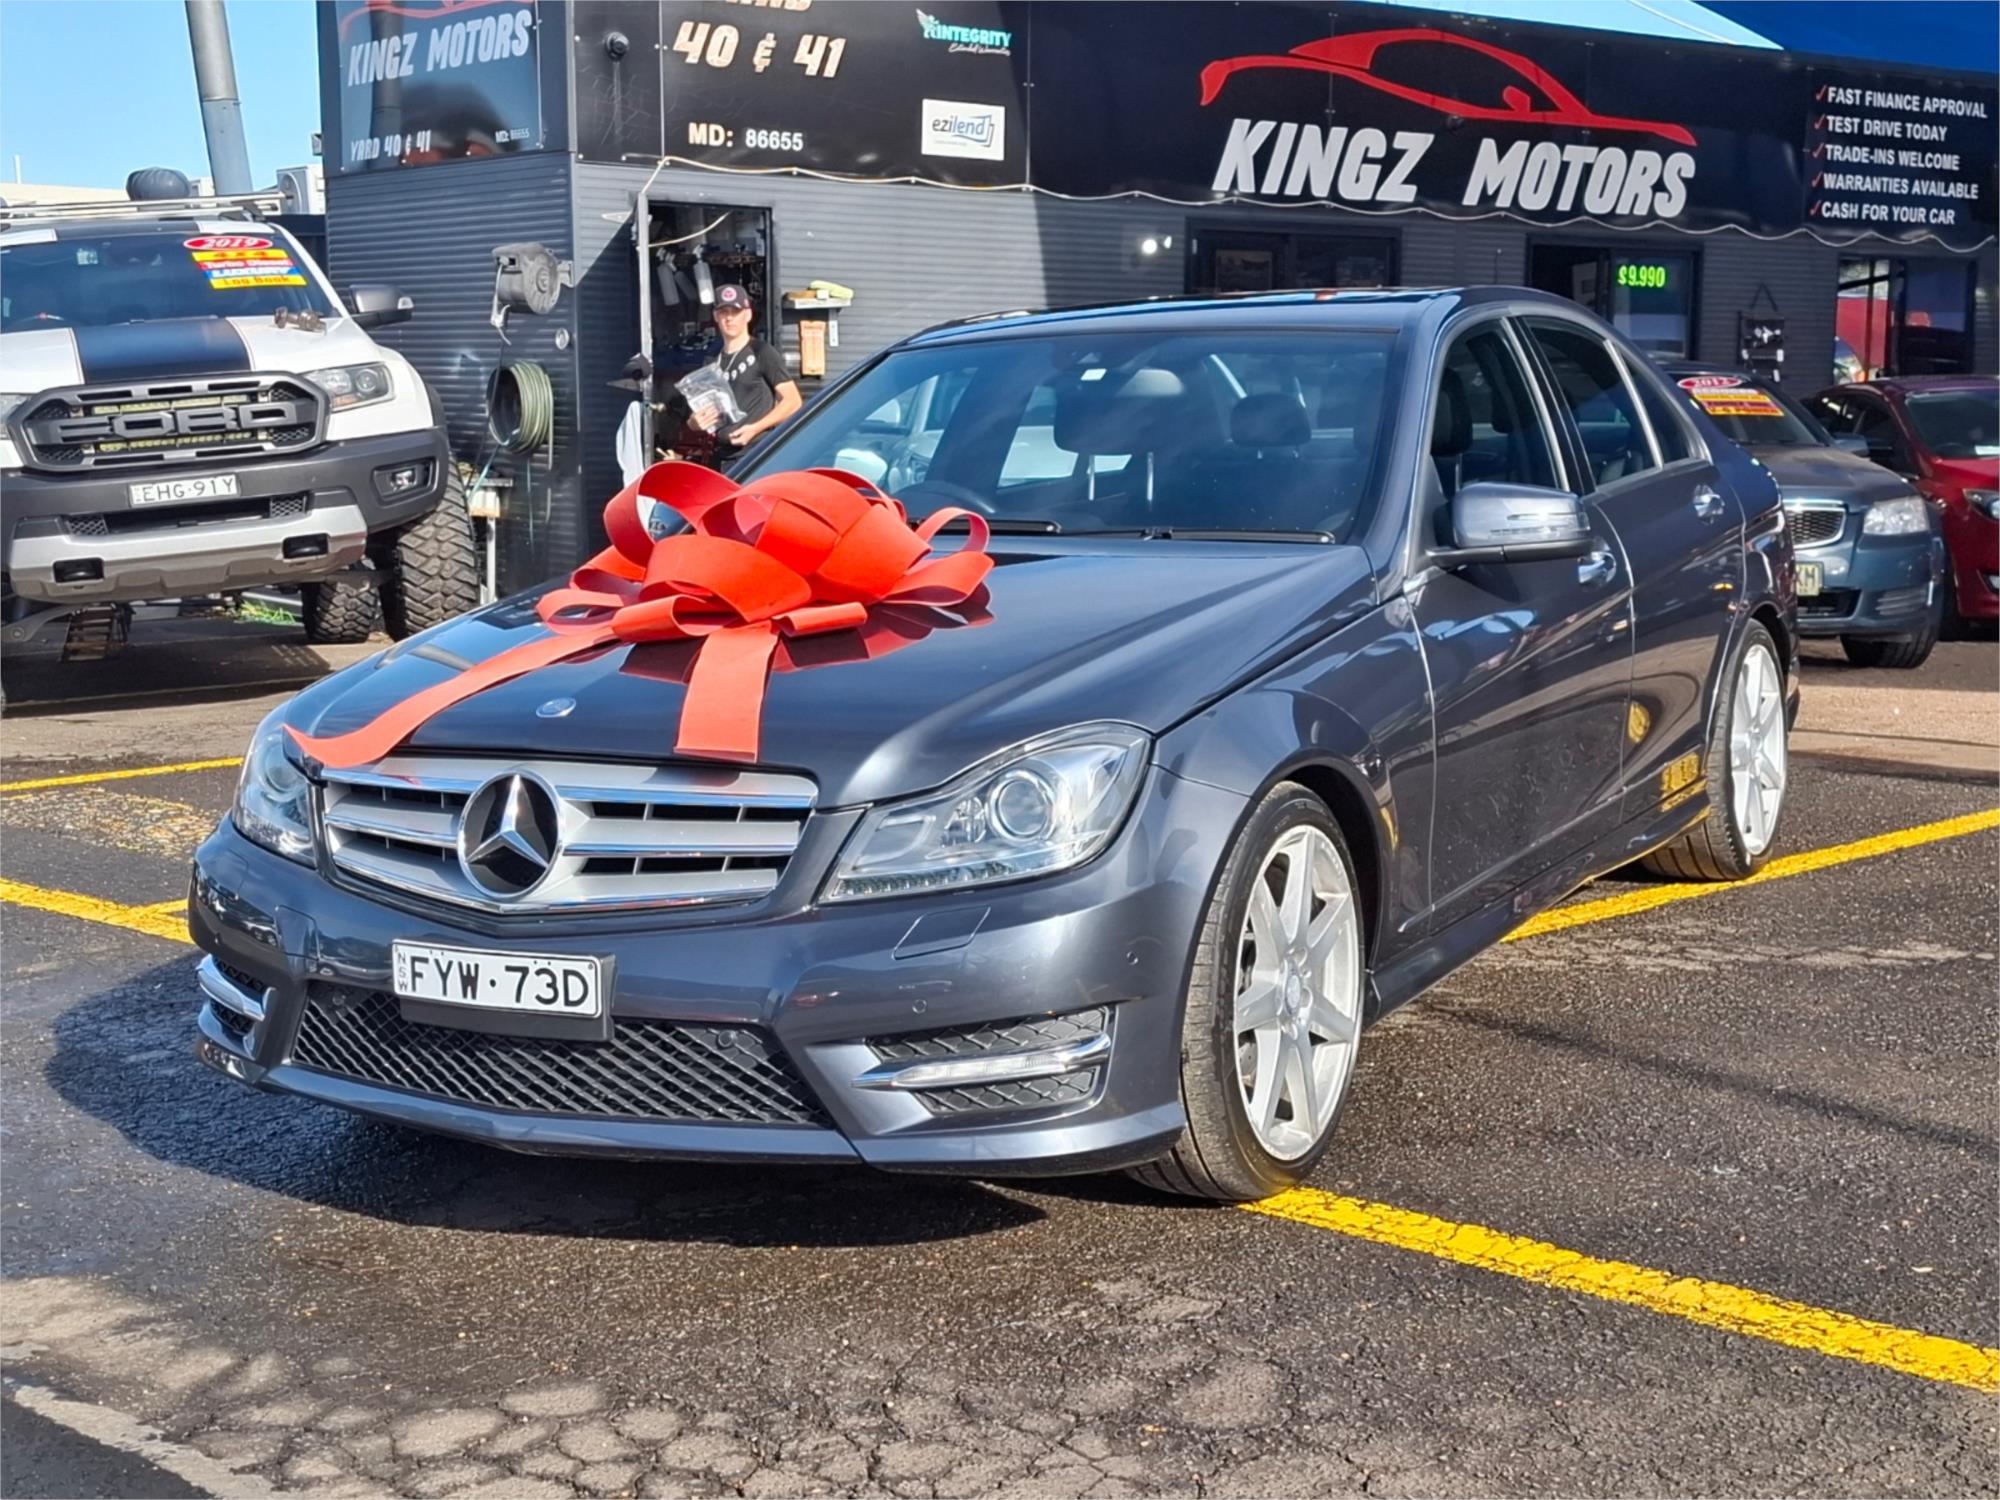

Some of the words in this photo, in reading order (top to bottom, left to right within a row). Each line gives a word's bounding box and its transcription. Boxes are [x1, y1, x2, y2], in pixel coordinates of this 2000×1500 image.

[348, 31, 418, 87] KINGZ
[426, 9, 532, 72] MOTORS
[673, 21, 740, 68] 40
[793, 34, 846, 78] 41
[936, 24, 1012, 47] INTEGRITY
[1827, 86, 1862, 104] FAST
[1865, 90, 1920, 112] FINANCE
[1923, 97, 1988, 118] APPROVAL
[688, 122, 734, 148] MD:
[745, 129, 804, 151] 86655
[932, 115, 986, 135] ezilend
[1826, 115, 1861, 134] TEST
[1863, 119, 1902, 137] DRIVE
[1905, 122, 1947, 141] TODAY
[351, 137, 380, 162] YARD
[384, 134, 402, 157] 40
[416, 130, 432, 153] 41
[1825, 144, 1895, 165] TRADE-INS
[1898, 150, 1960, 171] WELCOME
[1211, 118, 1435, 202] KINGZ
[1462, 138, 1696, 218] MOTORS
[1823, 173, 1909, 194] WARRANTIES
[1911, 179, 1979, 200] AVAILABLE
[1821, 201, 1859, 219] CASH
[1861, 205, 1888, 221] FOR
[1892, 206, 1927, 223] YOUR
[1929, 209, 1956, 225] CAR
[203, 238, 258, 249] 2019
[56, 402, 297, 445] FORD
